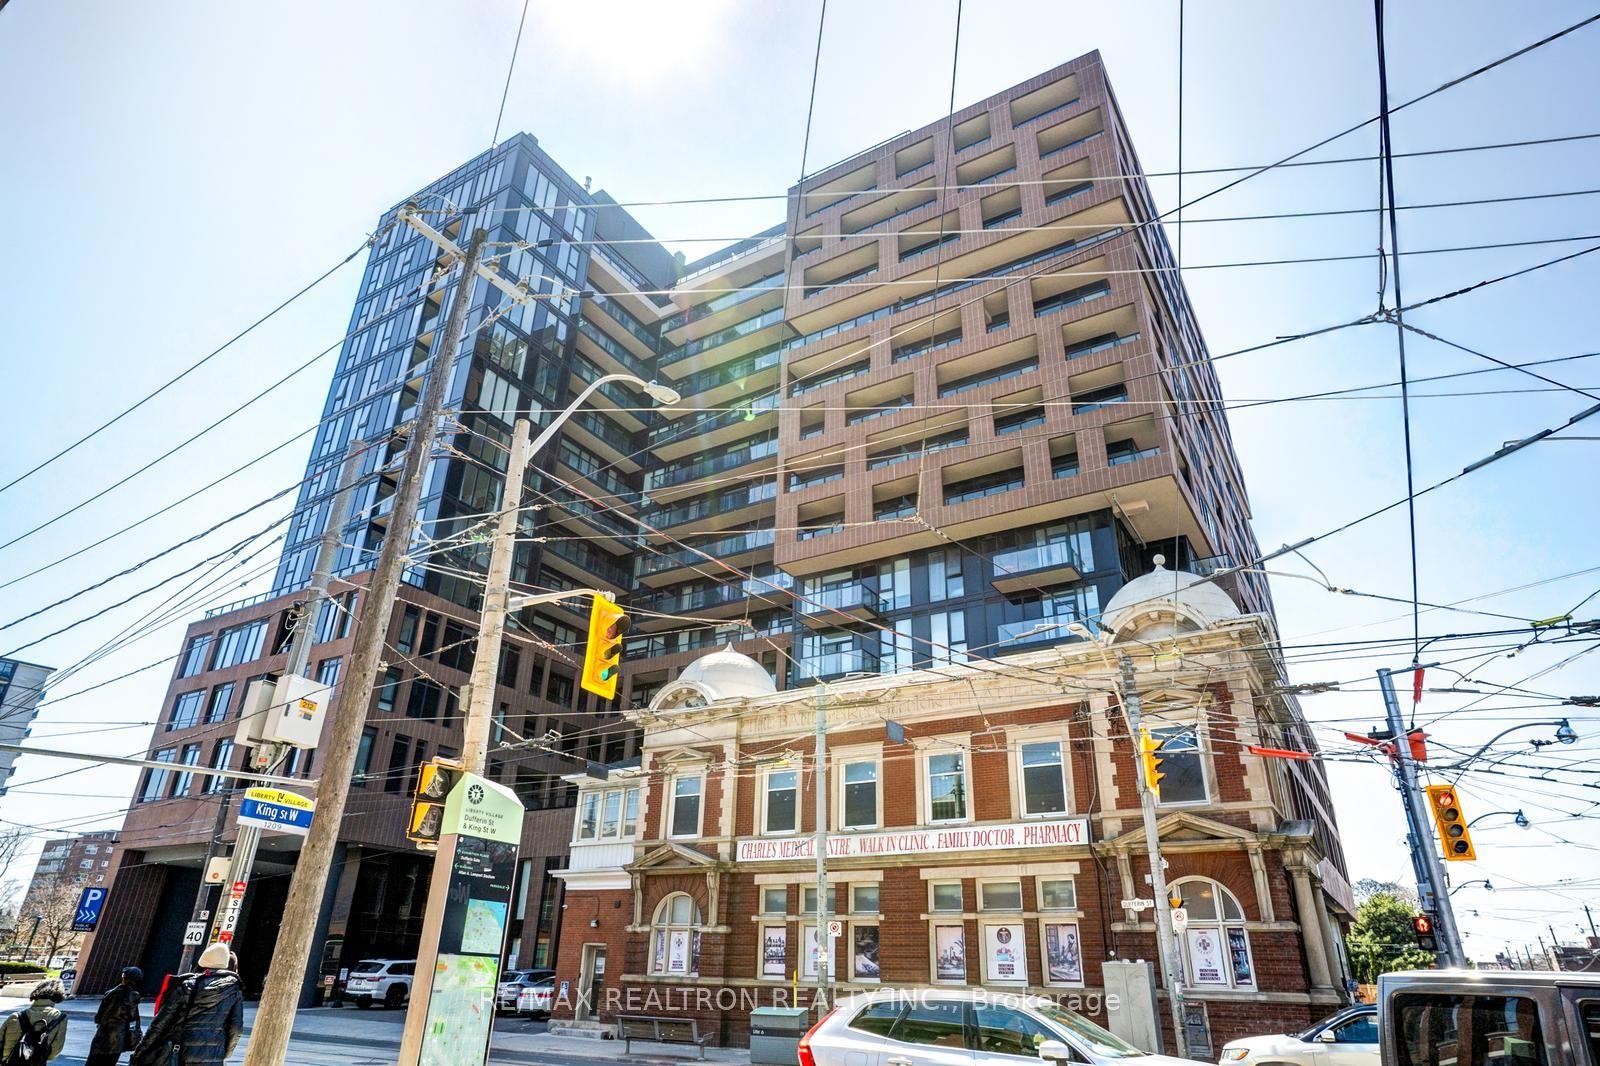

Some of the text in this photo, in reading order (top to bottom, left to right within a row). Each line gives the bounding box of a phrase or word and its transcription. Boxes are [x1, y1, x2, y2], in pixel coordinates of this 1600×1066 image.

[302, 701, 314, 710] 212
[251, 791, 275, 800] LIBERTY
[285, 798, 308, 807] VILLAGE
[256, 803, 299, 821] King St W
[264, 822, 282, 830] 1209
[464, 814, 487, 825] Dufferin
[468, 823, 482, 833] King
[741, 840, 776, 859] CHARLES
[779, 838, 814, 858] MEDICAL
[859, 835, 884, 853] WALK
[886, 836, 896, 851] IN
[899, 833, 930, 851] CLINIC
[937, 831, 971, 848] FAMILY
[973, 828, 1014, 847] DOCTOR
[1024, 823, 1081, 845] PHARMACY
[85, 889, 102, 908] P
[226, 899, 239, 930] STOP
[186, 931, 203, 942] 40
